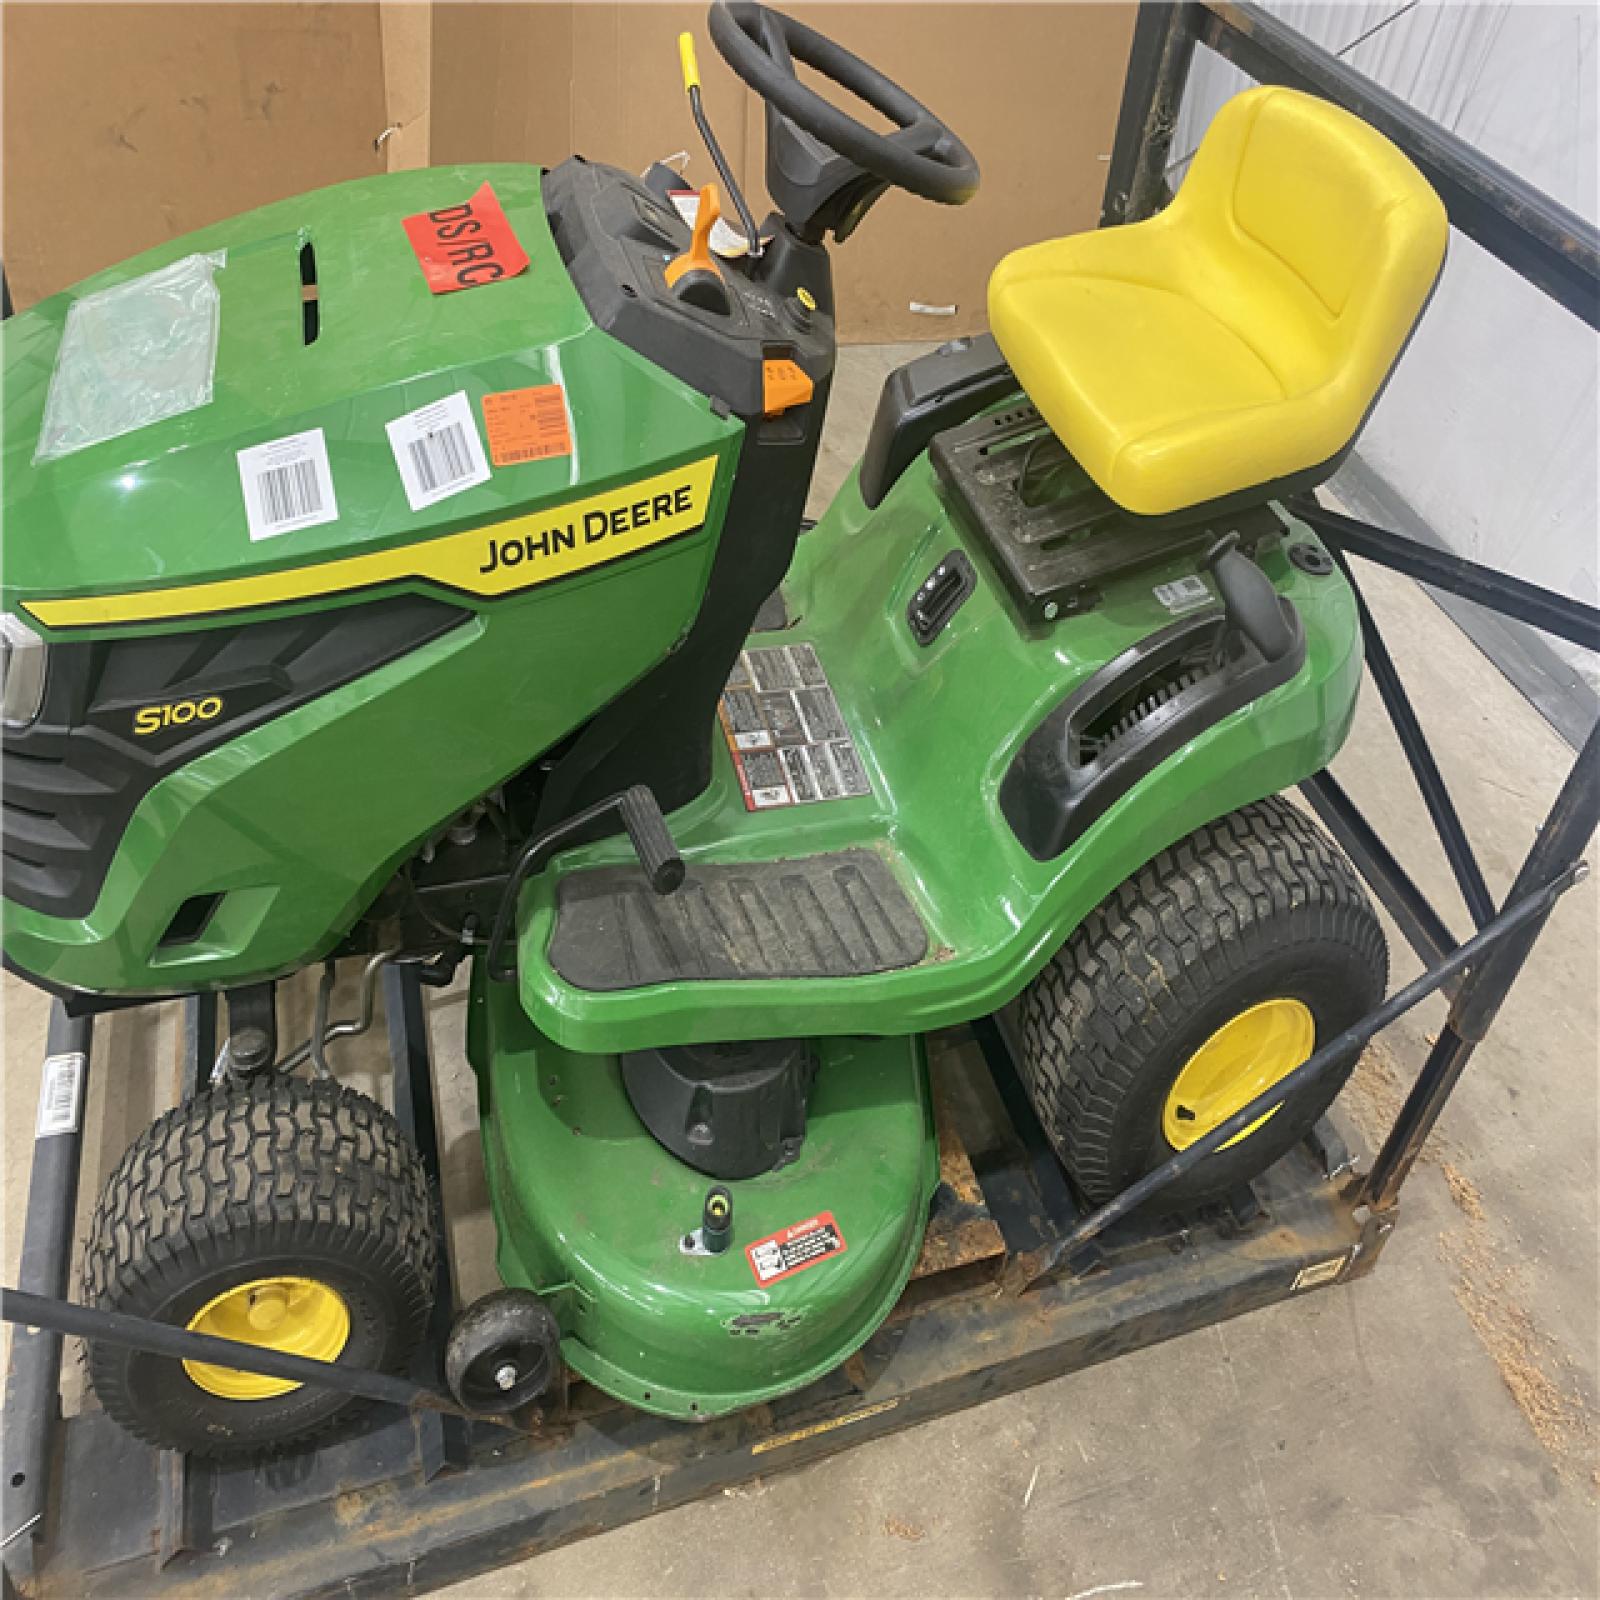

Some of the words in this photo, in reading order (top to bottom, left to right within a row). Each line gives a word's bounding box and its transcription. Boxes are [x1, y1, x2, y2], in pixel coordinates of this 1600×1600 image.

[428, 203, 504, 286] DS/RC
[479, 524, 576, 574] JOHN
[583, 485, 692, 545] DEERE
[134, 696, 223, 735] S100
